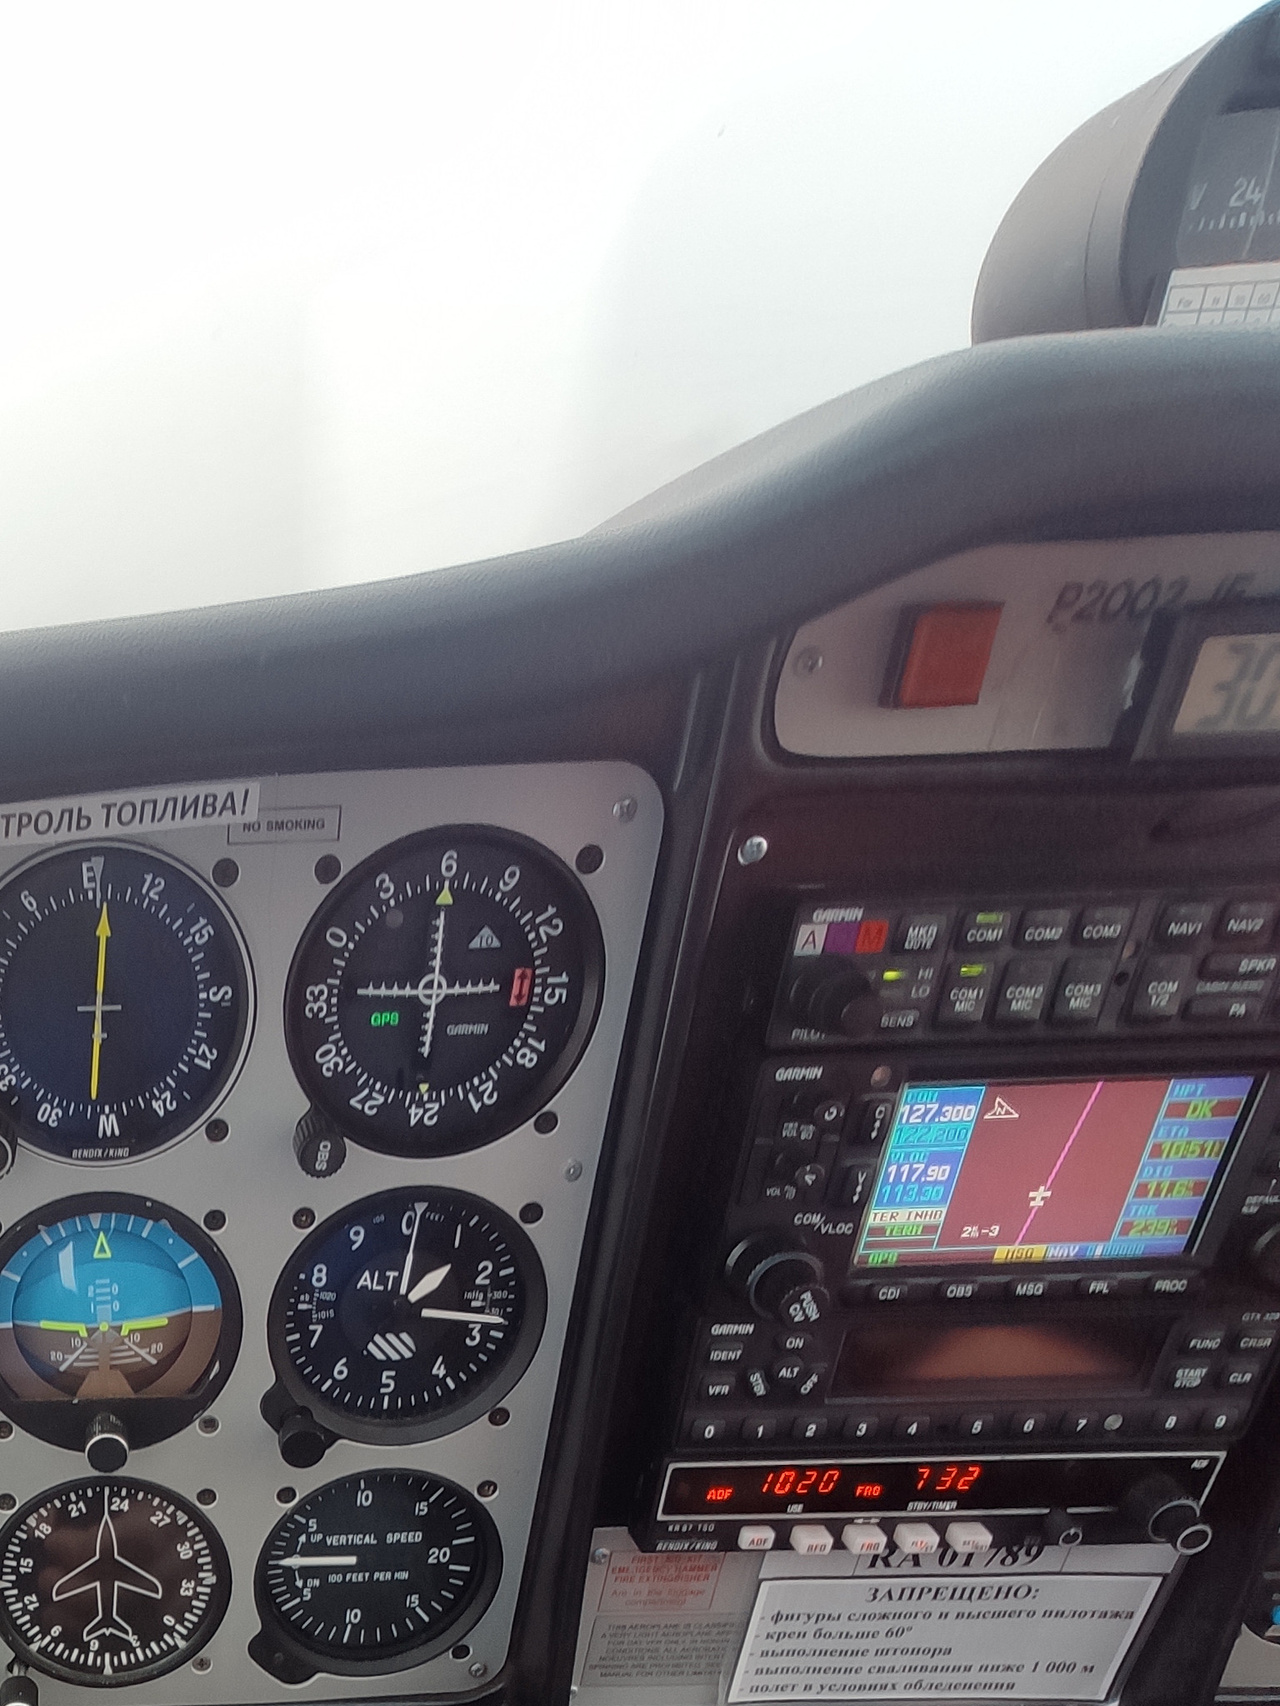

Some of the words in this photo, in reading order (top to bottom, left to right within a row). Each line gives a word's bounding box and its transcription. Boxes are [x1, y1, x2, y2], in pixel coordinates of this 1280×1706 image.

[101, 788, 250, 829] ТОПЛИВА!
[242, 821, 262, 833] NO
[266, 818, 325, 832] SMOKING
[813, 907, 864, 923] GARMIN
[1082, 924, 1121, 939] COM3
[1168, 922, 1202, 936] NAV1
[1227, 918, 1264, 933] NAV2
[966, 929, 1003, 942] COM1
[1024, 927, 1063, 942] COM2
[1239, 958, 1276, 975] SPKR
[209, 985, 232, 1003] S
[544, 971, 569, 1004] 15
[910, 986, 930, 998] LO
[950, 988, 983, 1000] COM1
[1006, 986, 1043, 999] COM2
[1065, 984, 1102, 997] COM3
[1148, 981, 1178, 994] COM
[305, 984, 328, 1018] 33
[954, 1001, 975, 1012] MIC
[1010, 999, 1033, 1012] MIC
[1069, 997, 1091, 1010] MIC
[370, 1012, 399, 1027] GPS
[446, 1023, 489, 1035] GARMIN
[775, 1066, 823, 1081] GARMIN
[409, 1102, 440, 1127] 24
[901, 1103, 975, 1124] 127.300
[1186, 1100, 1218, 1119] DK
[98, 1113, 119, 1139] W
[895, 1127, 970, 1144] 122.200
[72, 1147, 130, 1159] BENDIX/KING
[316, 1140, 331, 1171] OBS
[887, 1163, 950, 1183] 117.90
[882, 1185, 945, 1203] 113.30
[872, 1212, 899, 1222] TER
[357, 1269, 399, 1292] ALT
[1154, 1279, 1188, 1293] PROC
[878, 1287, 900, 1300] CDI
[946, 1285, 972, 1298] OBS
[1015, 1283, 1043, 1296] MSG
[1089, 1281, 1109, 1295] FPL
[711, 1323, 755, 1335] GARMIN
[786, 1337, 804, 1349] ON
[1189, 1338, 1221, 1349] FUNC
[710, 1350, 742, 1361] IDENT
[778, 1367, 800, 1378] ALT
[1228, 1372, 1252, 1384] CLR
[709, 1384, 729, 1396] VFR
[801, 1373, 819, 1395] OFF
[762, 1469, 840, 1495] 1020
[916, 1466, 981, 1491] 732
[357, 1490, 373, 1507] 10
[707, 1487, 734, 1501] ADF
[415, 1501, 428, 1516] 15
[787, 1504, 804, 1513] USE
[310, 1533, 323, 1543] UP
[326, 1534, 377, 1547] VERTICAL
[386, 1531, 423, 1544] SPEED
[748, 1537, 769, 1548] ADF
[427, 1547, 451, 1564] 20
[346, 1572, 369, 1583] FEET
[373, 1571, 391, 1581] PER
[394, 1570, 409, 1580] MIN
[866, 1584, 1040, 1603] ЗАПРЕЩЕНО:
[406, 1594, 420, 1608] 15
[346, 1608, 361, 1624] 10
[770, 1610, 841, 1625] фигуры
[847, 1610, 932, 1622] сложного
[938, 1611, 949, 1620] и
[955, 1609, 1036, 1620] высшего
[1041, 1609, 1135, 1620] пилотажа
[765, 1630, 809, 1643] крен
[813, 1627, 880, 1640] больше
[760, 1648, 870, 1658] выполнение
[874, 1647, 953, 1659] штопора
[754, 1666, 863, 1676] выполнение
[867, 1664, 973, 1675] сваливания
[978, 1662, 1024, 1673] ниже
[1081, 1664, 1095, 1673] м
[749, 1683, 798, 1694] полет
[803, 1683, 813, 1692] в
[816, 1682, 897, 1695] условиях
[903, 1680, 1016, 1692] обледенения
